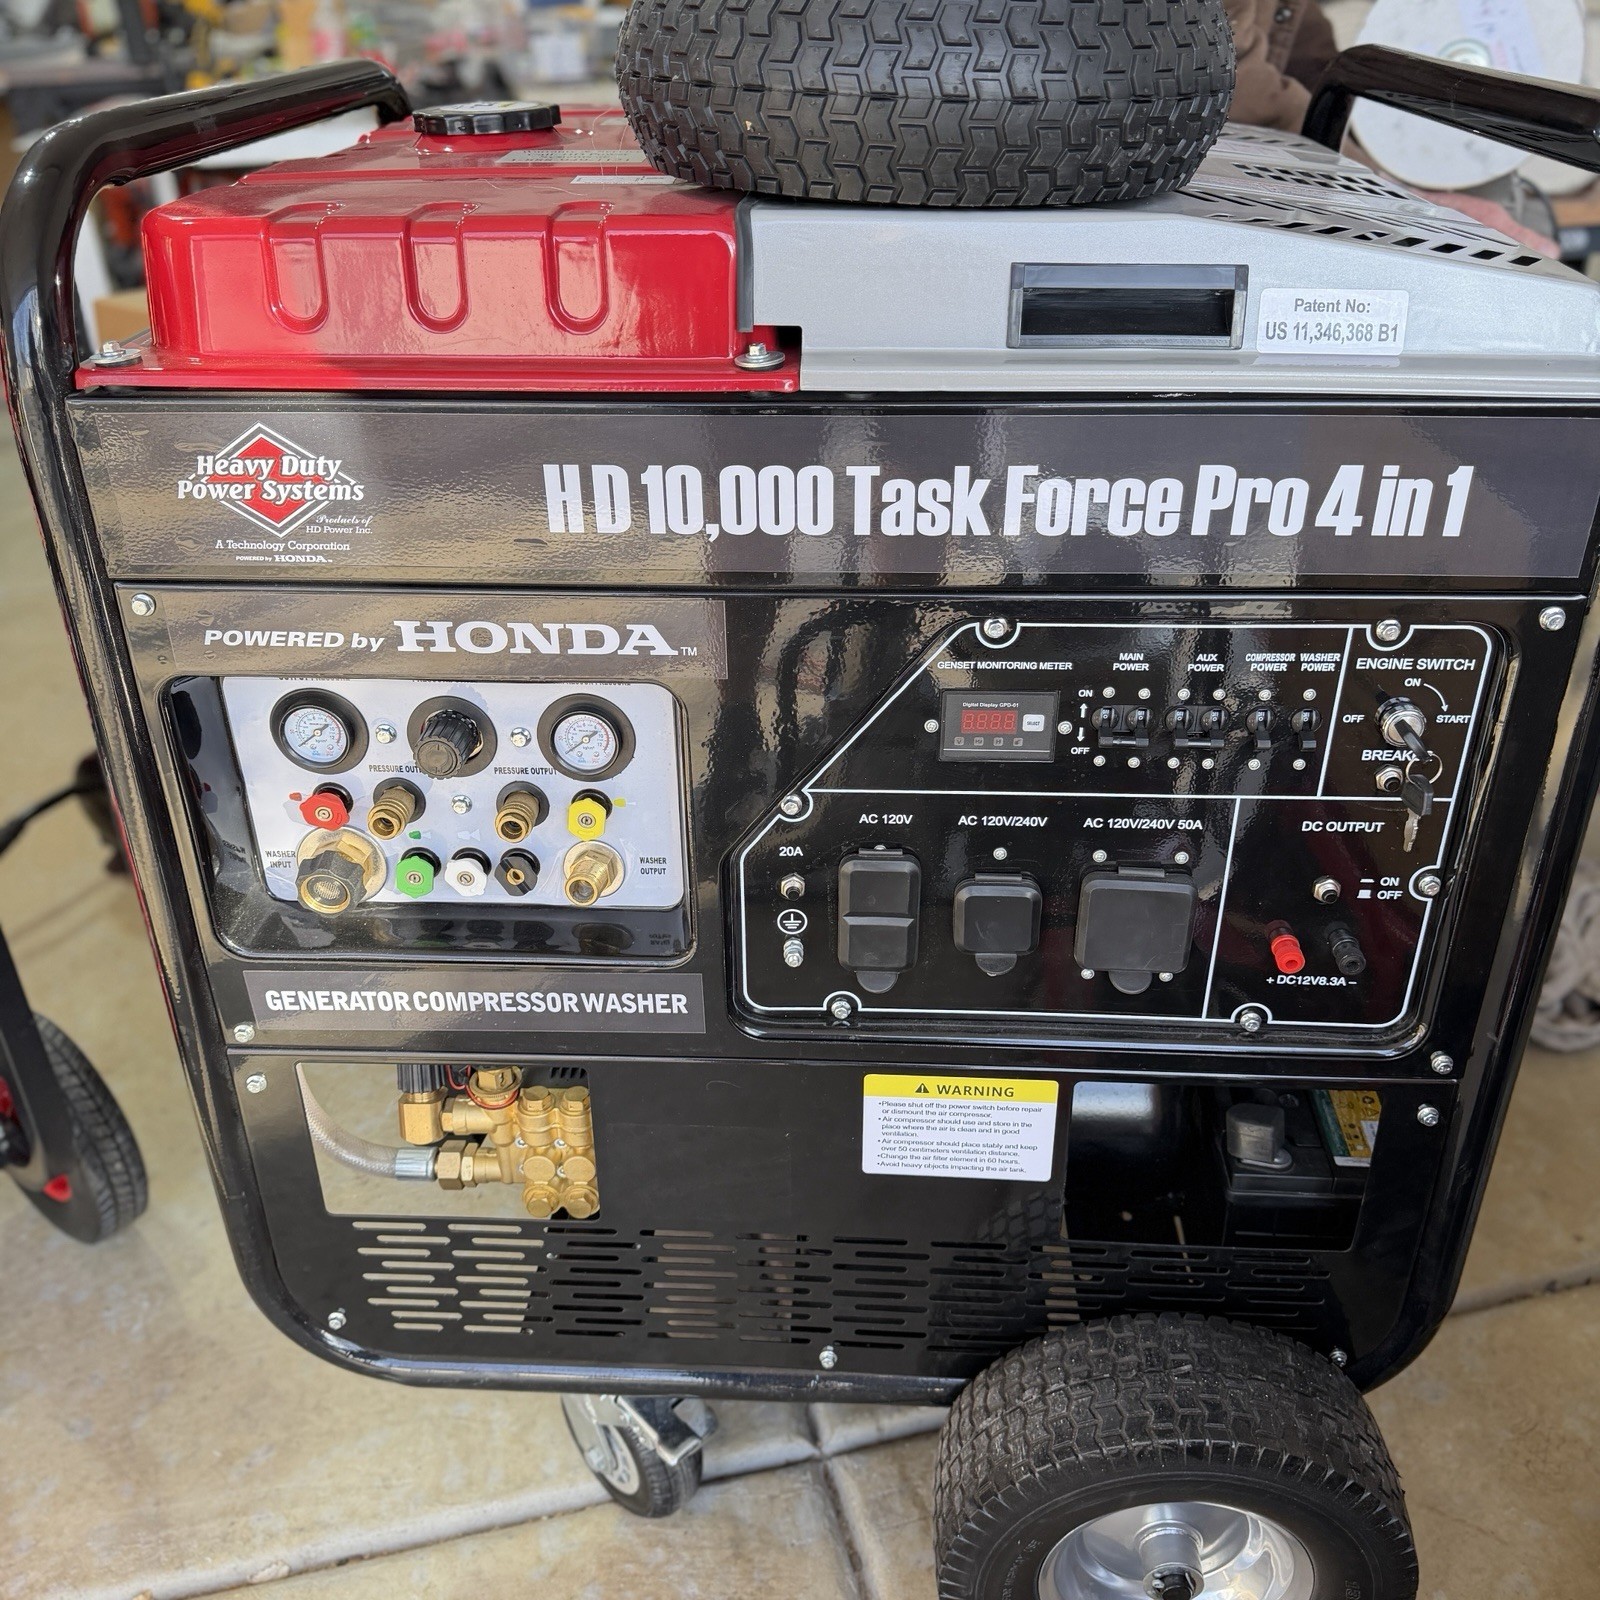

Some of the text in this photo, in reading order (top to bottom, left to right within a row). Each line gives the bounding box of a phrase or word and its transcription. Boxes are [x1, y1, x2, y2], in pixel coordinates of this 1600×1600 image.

[1294, 298, 1370, 314] Patent No:
[1266, 322, 1398, 344] US 11,346,368 B1
[197, 455, 342, 480] Heavy Duty
[178, 480, 364, 504] Power Systems
[640, 464, 834, 542] 10,000
[846, 466, 991, 536] Task
[1002, 465, 1185, 536] Force
[1190, 464, 1310, 536] Pro
[1314, 464, 1364, 536] 4
[1370, 464, 1434, 536] in
[1442, 466, 1475, 537] 1
[316, 514, 374, 527] Products of
[306, 526, 372, 534] HD Power Inc.
[214, 540, 350, 552] A Technology Corporation
[204, 629, 344, 648] POWERED
[351, 631, 384, 652] by
[394, 620, 679, 656] HONDA
[1119, 652, 1144, 662] MAIN
[1196, 653, 1219, 662] AUX
[1246, 653, 1296, 662] COMPRESSOR
[1300, 652, 1341, 662] WASHER
[937, 661, 1073, 670] GENSET MONITORING METER
[1112, 662, 1149, 672] POWER
[1188, 662, 1225, 672] POWER
[1250, 662, 1288, 672] POWER
[1301, 662, 1336, 672] POWER
[1356, 658, 1476, 671] ENGINE SWITCH
[1404, 678, 1422, 687] ON
[1078, 689, 1093, 698] ON
[1342, 714, 1364, 723] OFF
[1436, 714, 1472, 724] START
[1070, 746, 1090, 755] OFF
[368, 764, 404, 773] PRESSURE
[494, 766, 558, 776] PRESSURE OUTPUT
[859, 814, 913, 826] AC 120V
[958, 815, 1048, 828] AC 120V/240V
[1083, 818, 1204, 831] AC 120V/240V 50A
[1302, 820, 1386, 833] DC OUTPUT
[265, 850, 296, 858] WASHER
[778, 846, 804, 857] 20A
[640, 856, 667, 864] WASHER
[1380, 877, 1400, 887] ON
[1376, 890, 1403, 900] OFF
[264, 990, 689, 1015] GENERATOR COMPRESSOR WASHER
[937, 1084, 1014, 1097] WARNING
